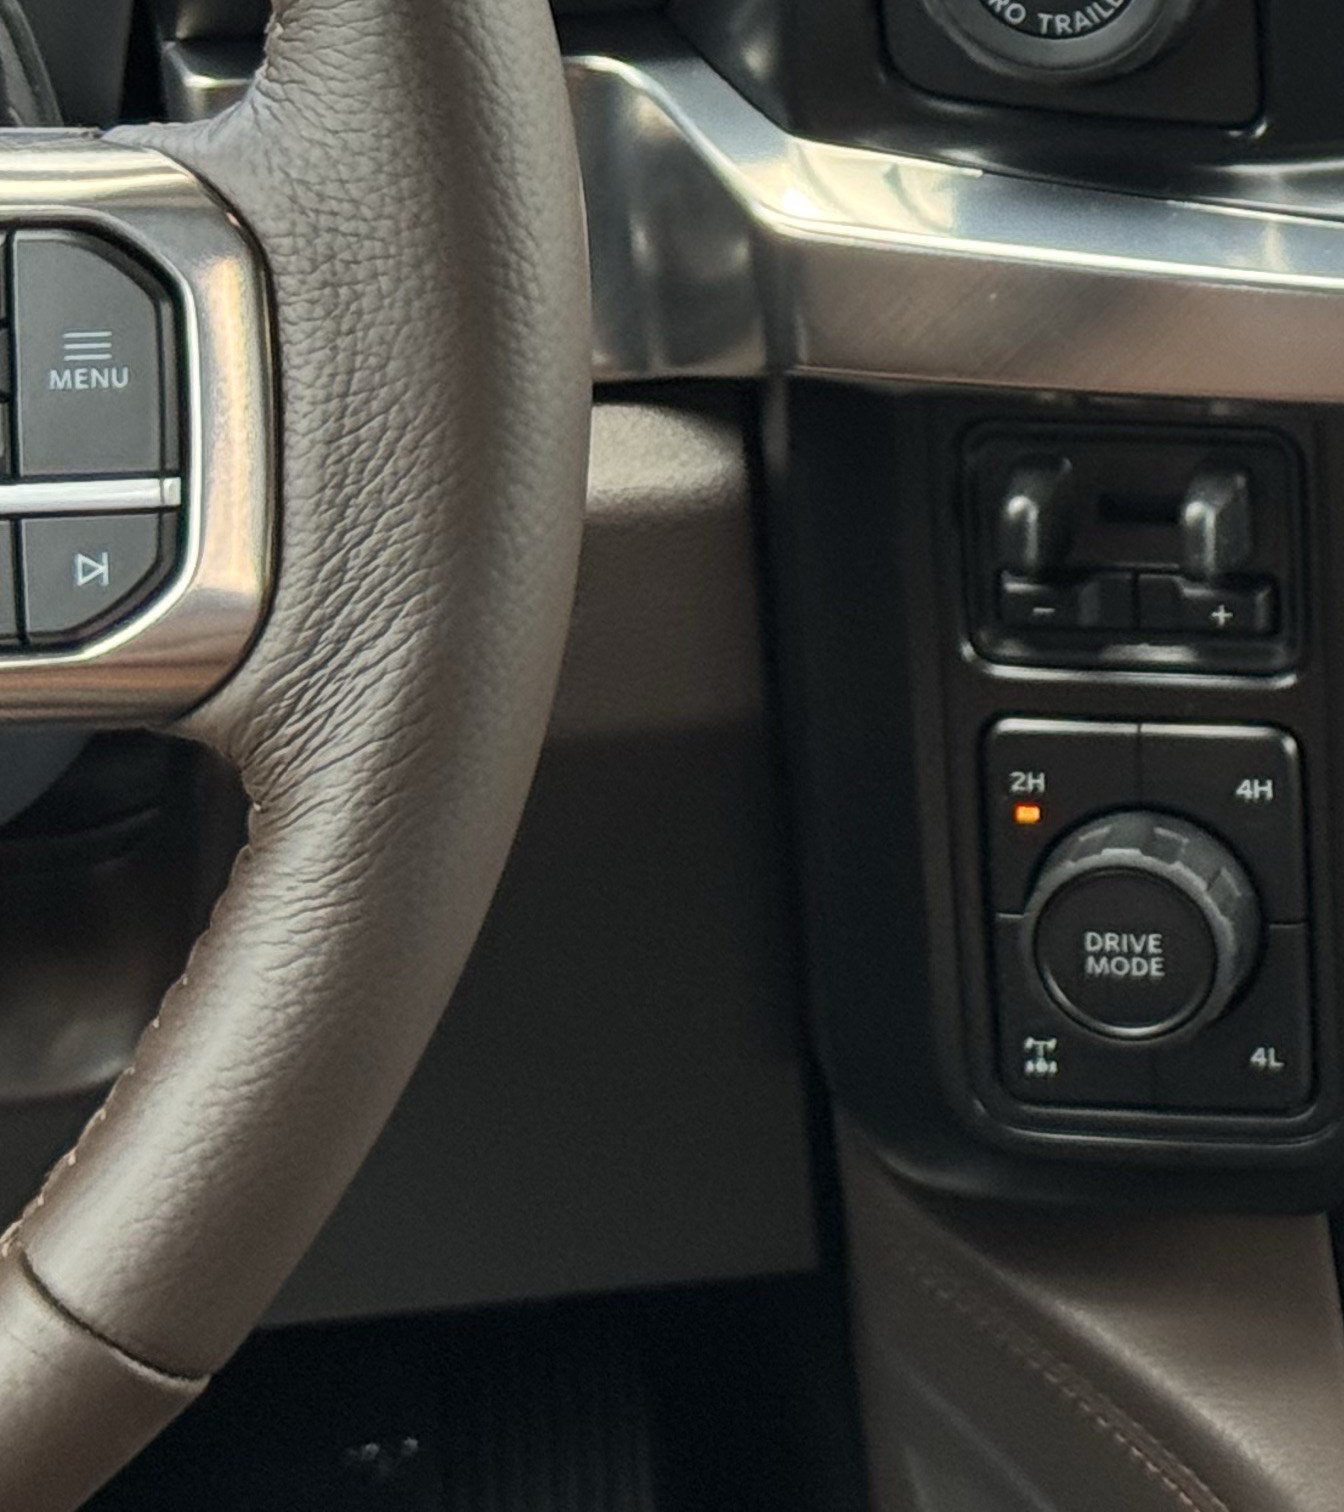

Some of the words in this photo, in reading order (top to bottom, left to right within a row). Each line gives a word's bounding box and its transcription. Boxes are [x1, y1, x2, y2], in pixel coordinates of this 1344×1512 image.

[49, 367, 129, 390] MENU
[1010, 772, 1046, 794] 2H
[1235, 778, 1274, 802] 4H
[1084, 931, 1163, 955] DRIVE
[1085, 955, 1166, 978] MODE
[1250, 1046, 1285, 1070] 4L
